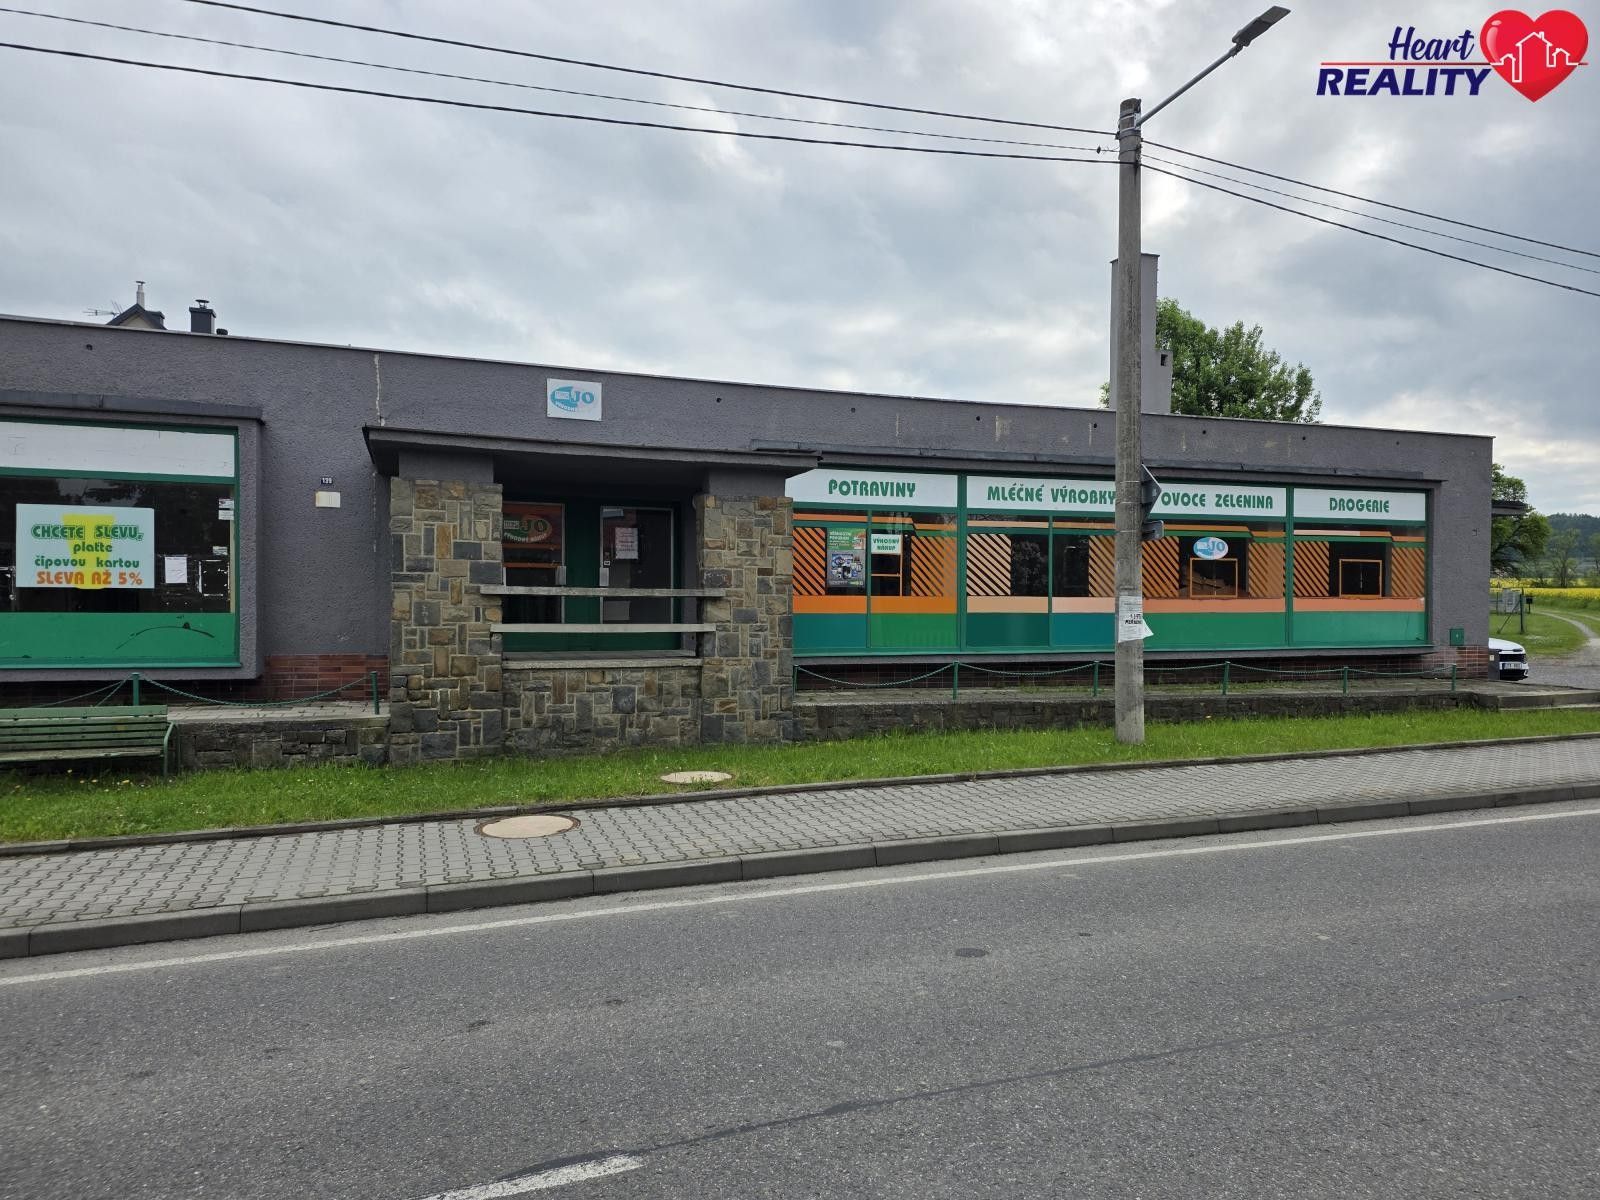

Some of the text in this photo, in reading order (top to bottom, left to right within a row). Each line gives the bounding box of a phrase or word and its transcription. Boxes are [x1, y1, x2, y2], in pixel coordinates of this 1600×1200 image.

[828, 479, 916, 498] POTRAVINY
[987, 482, 1274, 509] MLÉČNÉ VÝROBKY OVOCE ZELENINA
[1329, 497, 1390, 513] DROGERIE
[31, 524, 85, 540] CHCETE
[34, 555, 140, 569] čipovou kartou
[36, 569, 143, 585] SLEVA AŽ 5%
